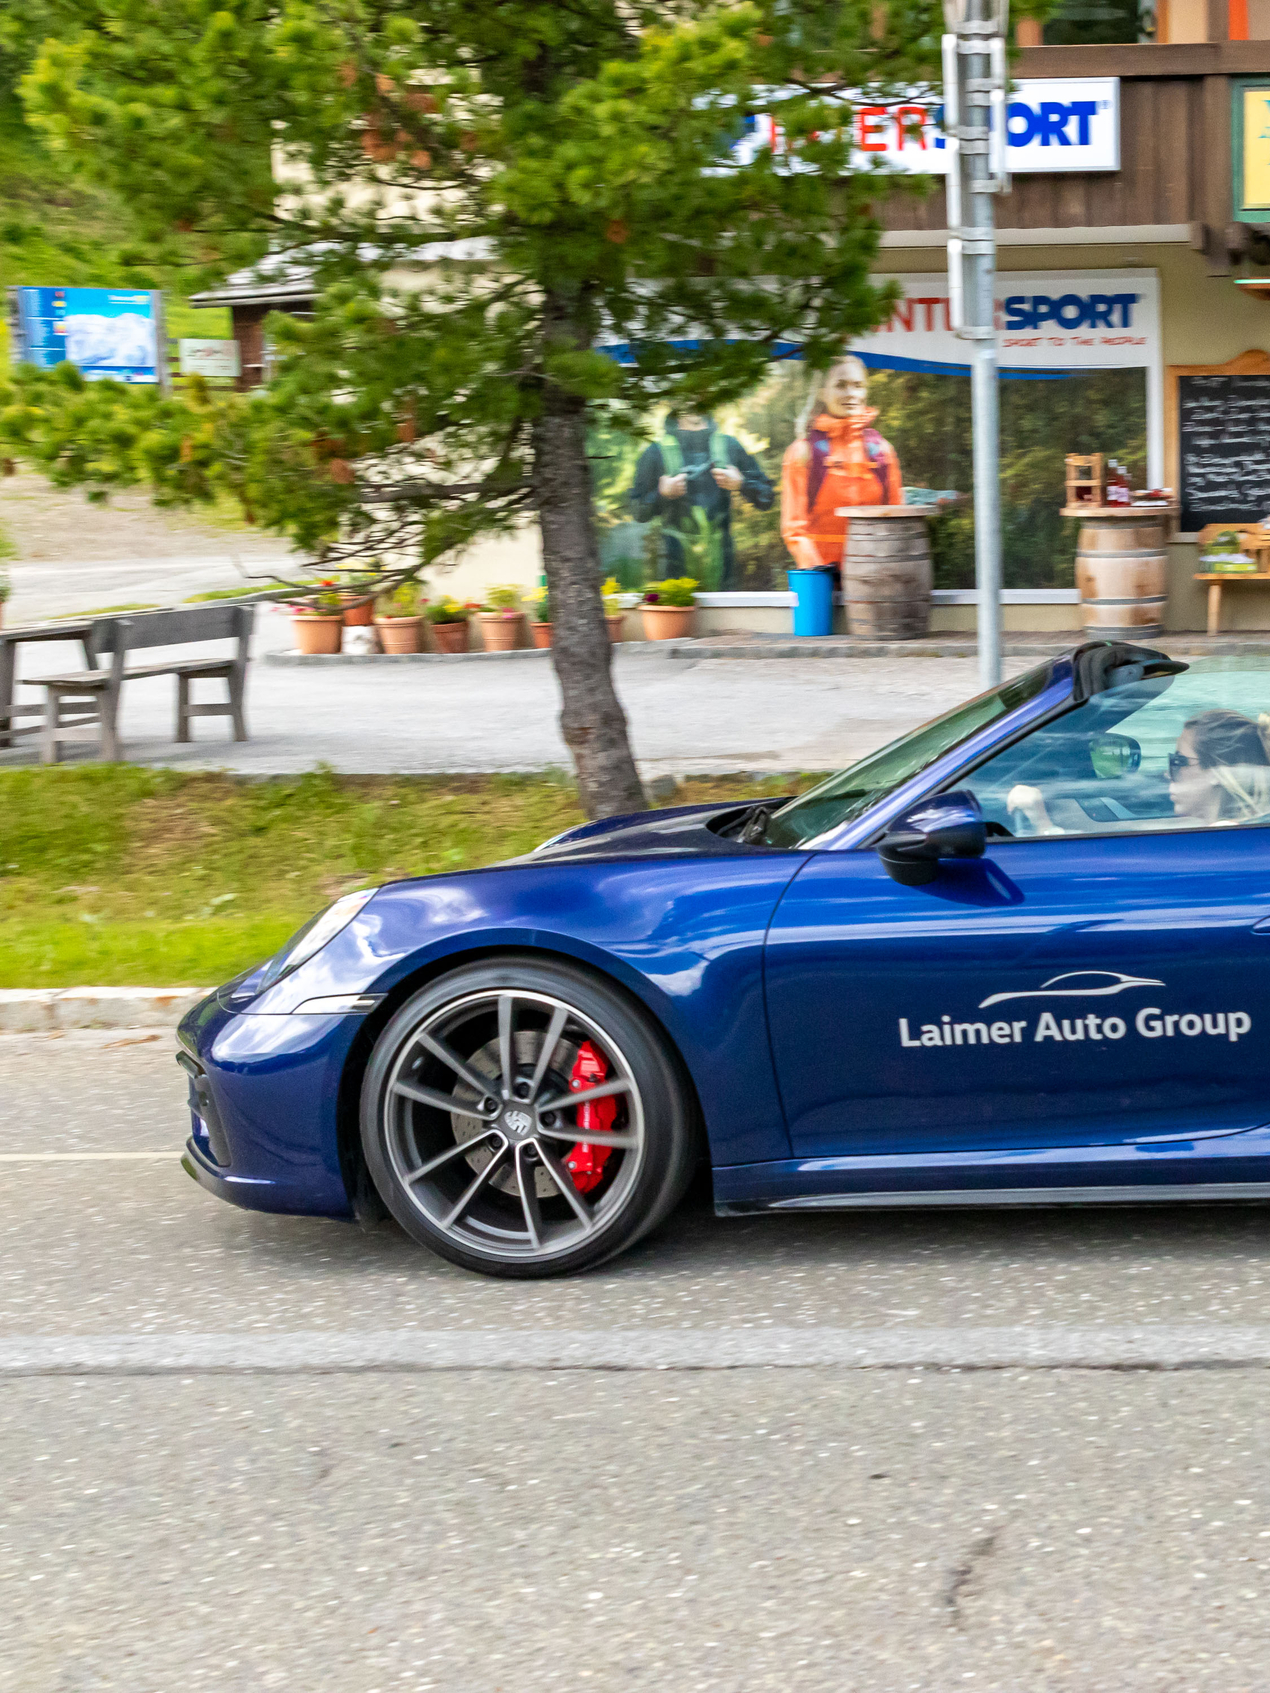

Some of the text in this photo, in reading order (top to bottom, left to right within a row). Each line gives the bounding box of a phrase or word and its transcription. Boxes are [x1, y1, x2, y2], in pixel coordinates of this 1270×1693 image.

[899, 1007, 1251, 1047] Laimer Auto Group
